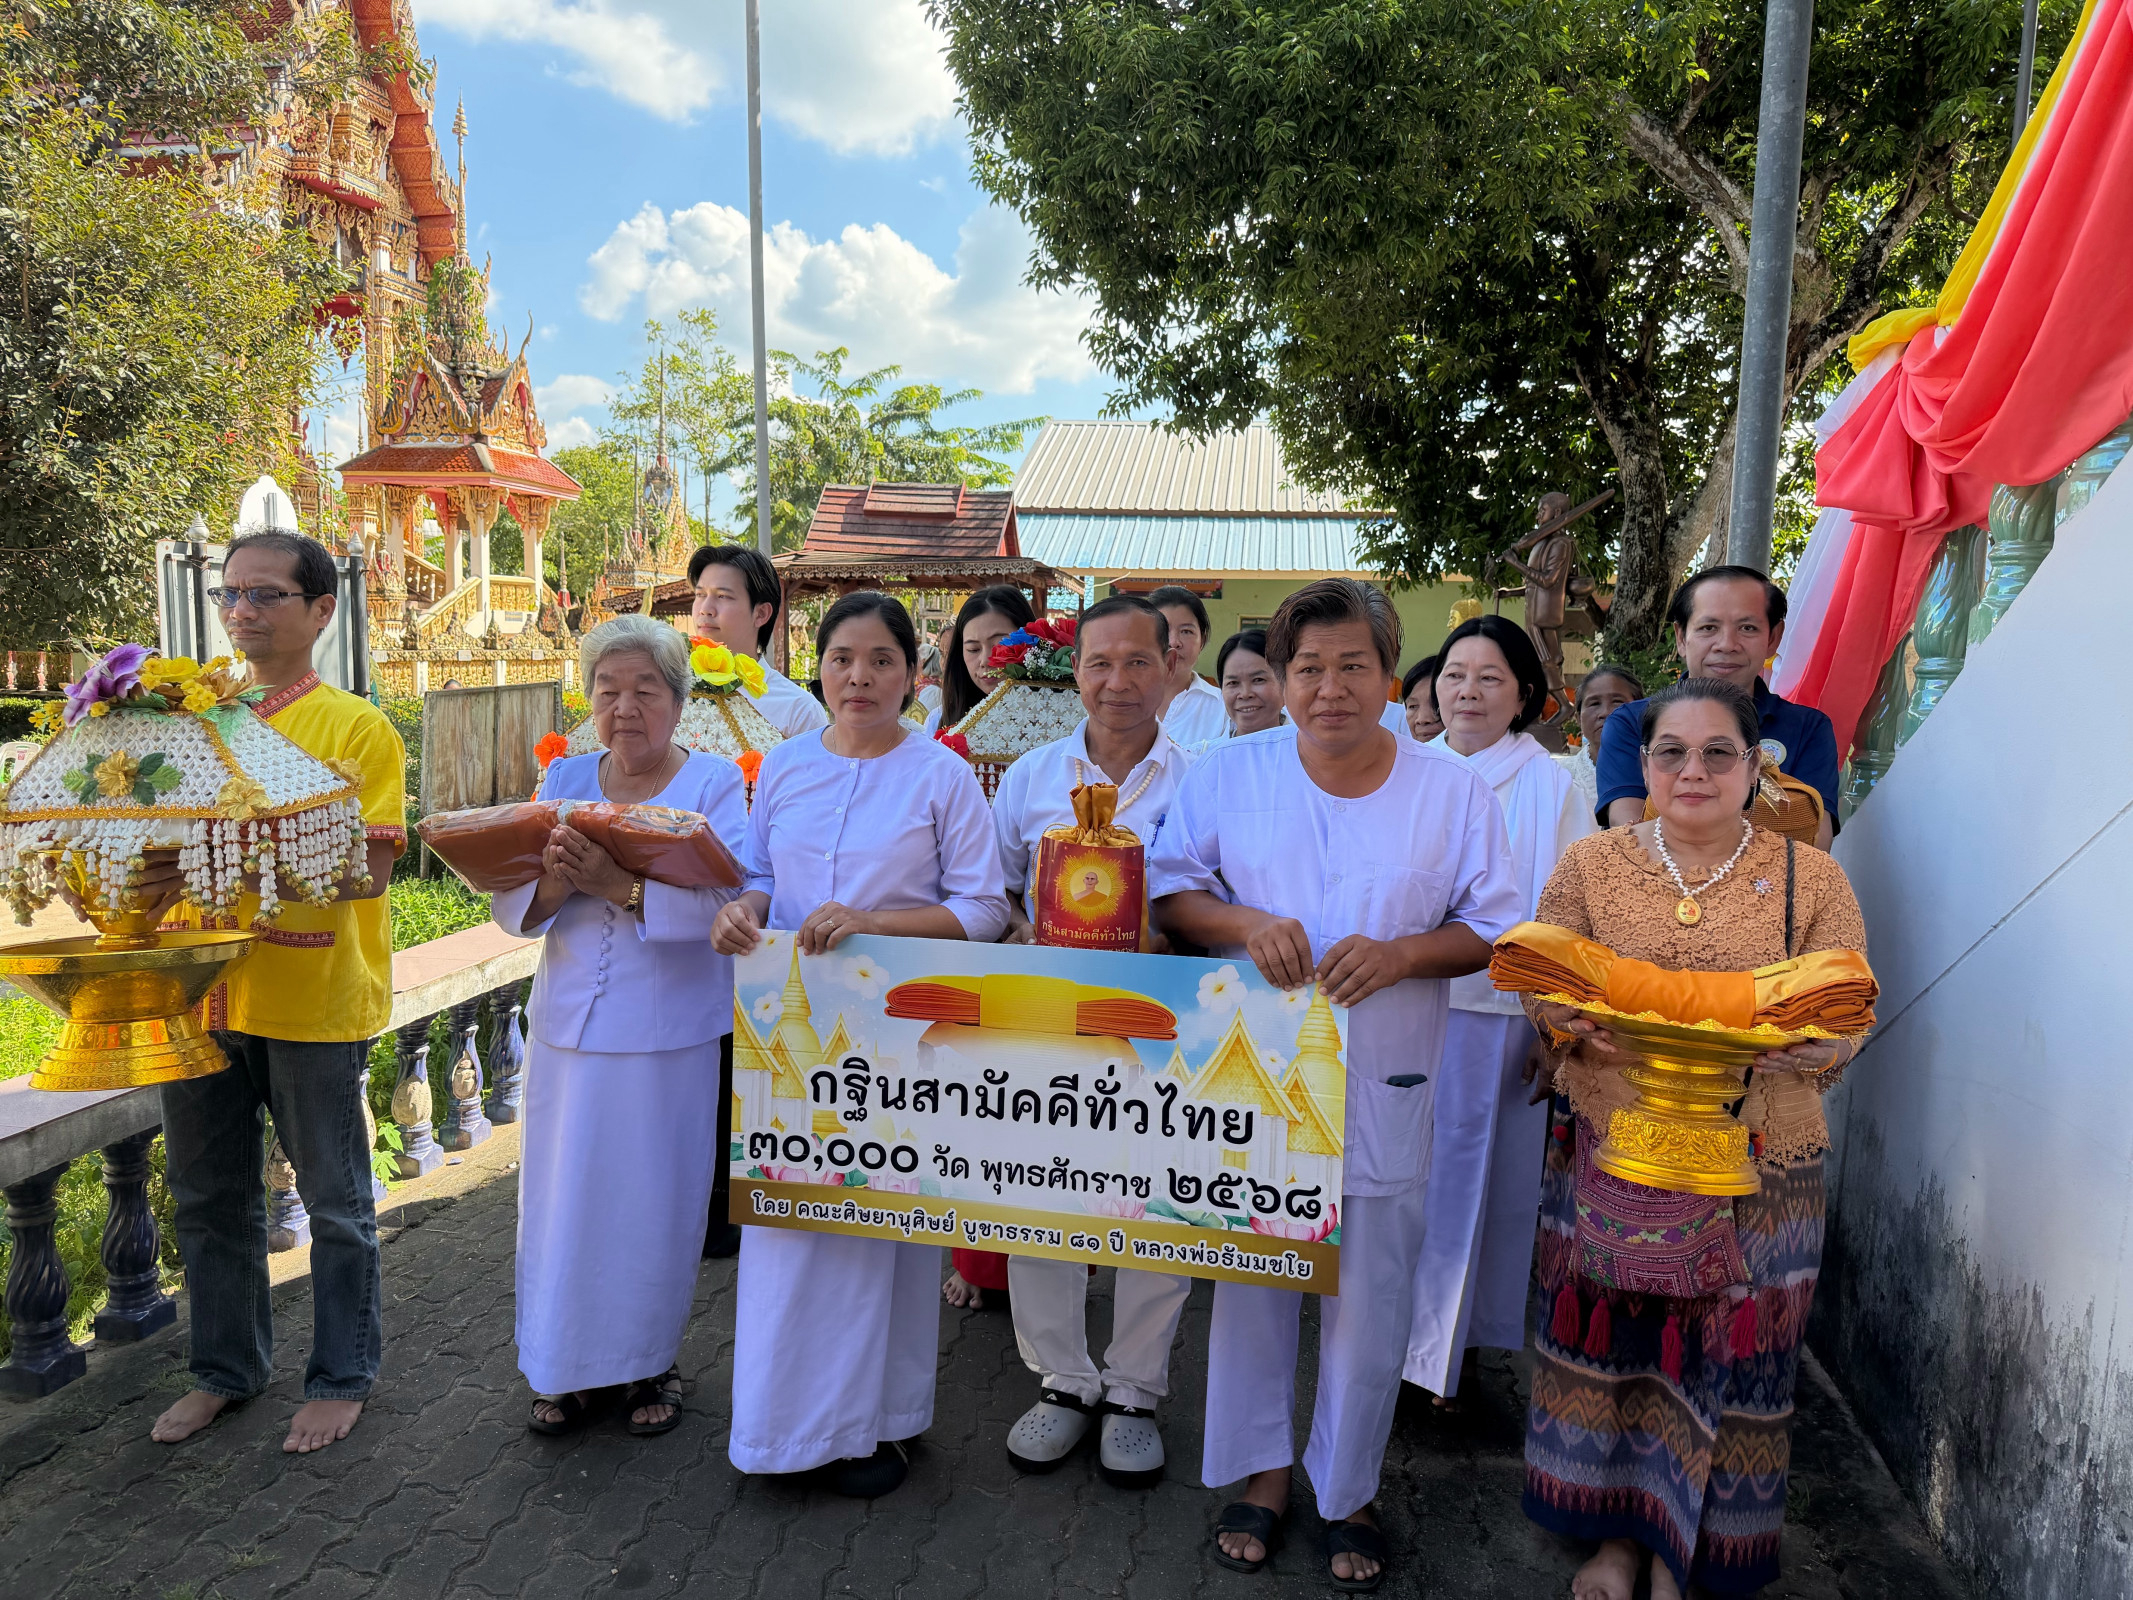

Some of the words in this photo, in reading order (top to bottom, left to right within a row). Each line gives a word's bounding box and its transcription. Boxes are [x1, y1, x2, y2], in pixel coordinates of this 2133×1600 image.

[1042, 921, 1136, 941] กฐินสามัคคีทั่วไทย
[809, 1056, 1254, 1145] กฐินสามัคคีทั่วไทย
[749, 1131, 919, 1173] ๓๐,๐๐๐
[932, 1143, 970, 1179] วัด
[980, 1155, 1151, 1198] พุทธศักราช
[1166, 1166, 1322, 1220] ๒๕๖๘
[752, 1192, 789, 1214] โดย
[798, 1201, 955, 1235] คณะศิษยานุศิษย์
[963, 1219, 1061, 1245] บูชาธรรม
[1070, 1233, 1101, 1250] ๘๑
[1109, 1231, 1124, 1252] ปี
[1133, 1239, 1311, 1278] หลวงพ่อธัมมชโย
